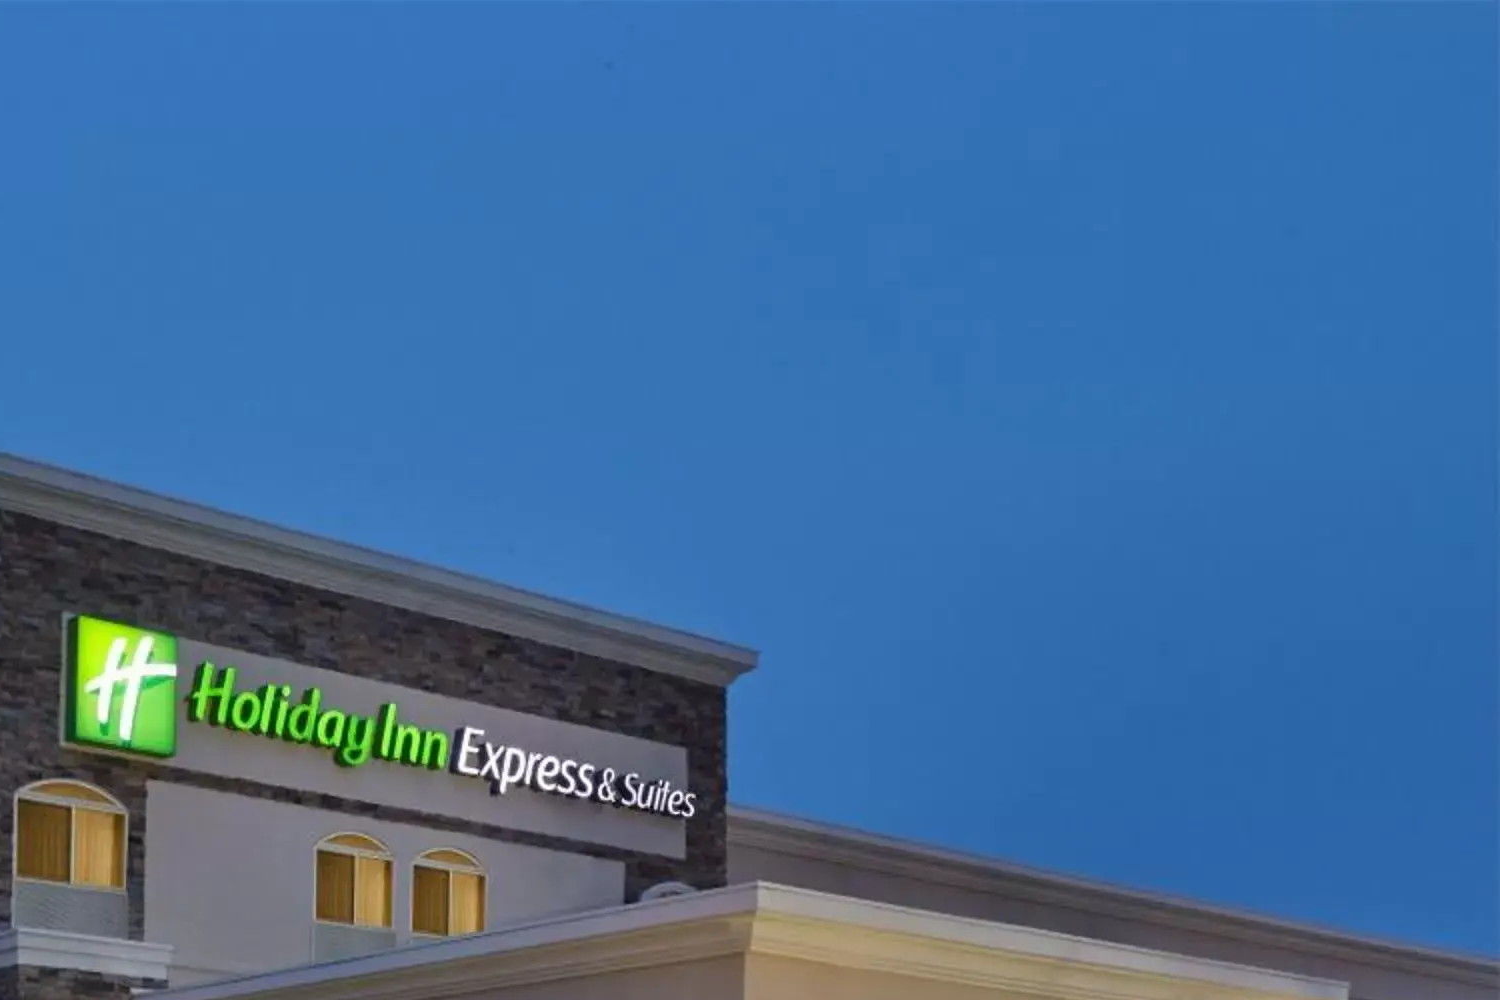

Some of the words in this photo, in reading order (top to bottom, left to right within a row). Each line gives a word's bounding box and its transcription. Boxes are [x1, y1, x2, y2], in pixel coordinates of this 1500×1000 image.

[192, 660, 375, 766] Holiday
[380, 703, 448, 769] Inn
[457, 726, 595, 796] Express
[597, 768, 617, 803] &
[621, 773, 697, 818] Suites
